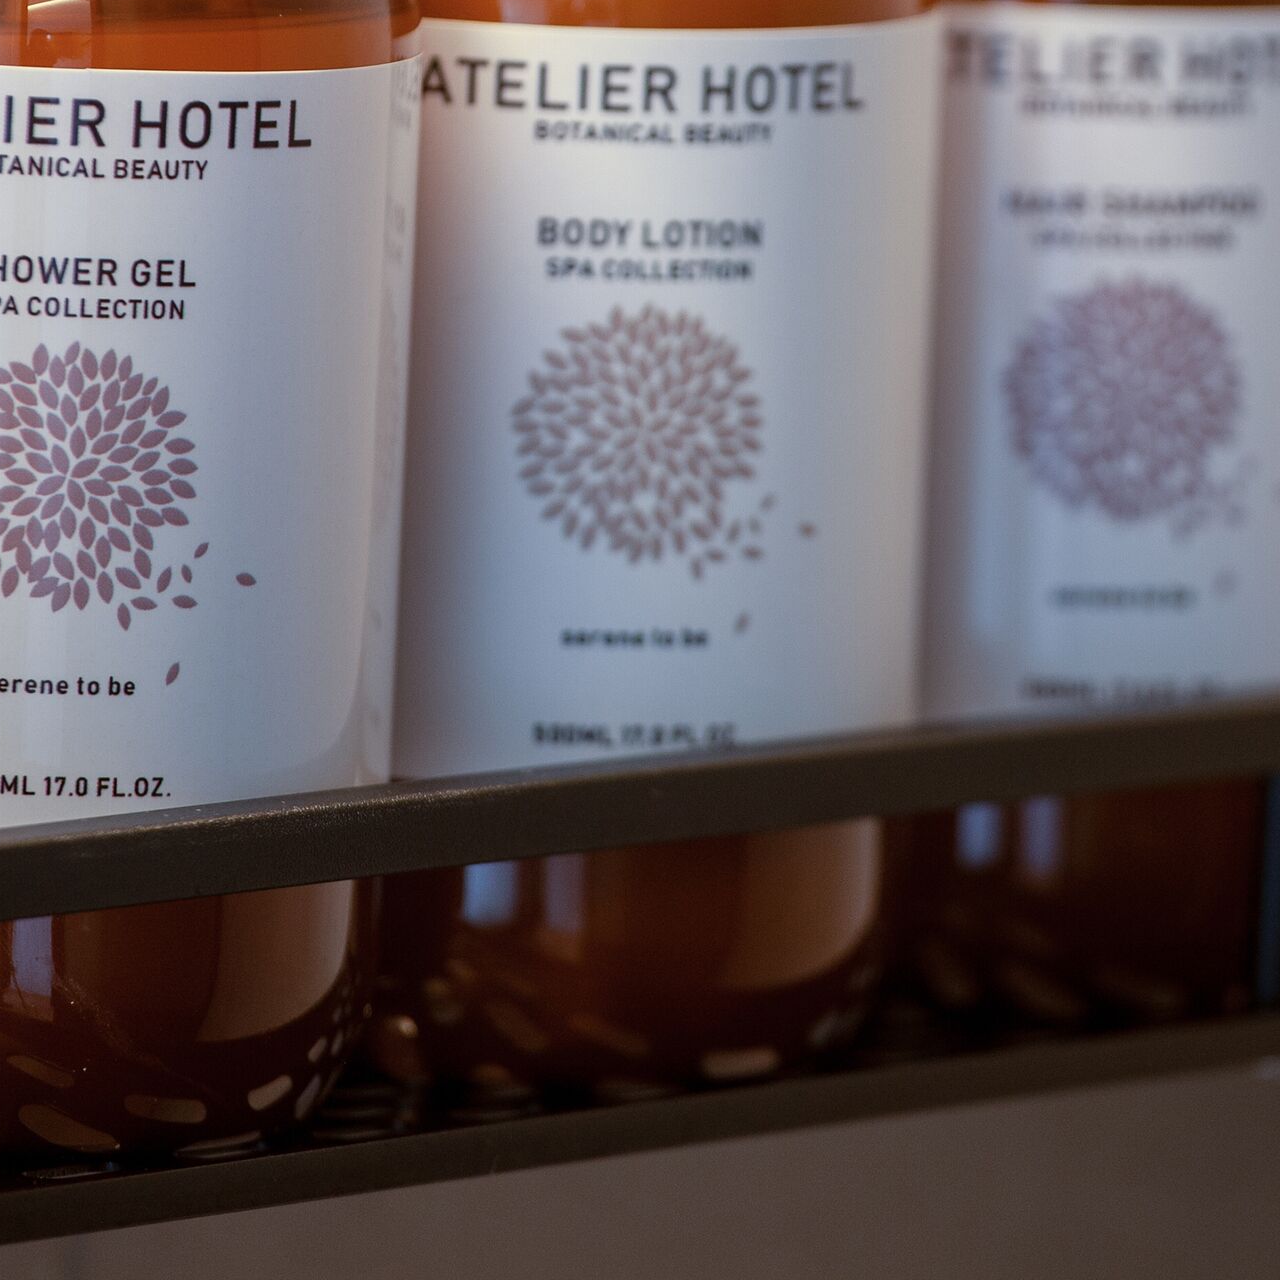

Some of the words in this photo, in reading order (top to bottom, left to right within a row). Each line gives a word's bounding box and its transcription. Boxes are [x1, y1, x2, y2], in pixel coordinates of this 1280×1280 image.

[944, 28, 1166, 86] TELIER
[420, 55, 678, 114] ATELIER
[701, 61, 864, 114] HOTEL
[132, 99, 312, 149] HOTEL
[534, 120, 674, 144] BOTANICAL
[683, 122, 775, 145] BEAUTY
[113, 159, 210, 181] BEAUTY
[537, 218, 634, 249] BODY
[641, 219, 764, 249] LOTION
[130, 259, 197, 288] GEL
[544, 256, 594, 280] SPA
[601, 257, 755, 281] COLLECTION
[26, 296, 186, 320] COLLECTION
[76, 676, 101, 697] to
[108, 676, 136, 697] be
[44, 776, 89, 798] 17.0
[96, 777, 172, 799] FL.OZ.
